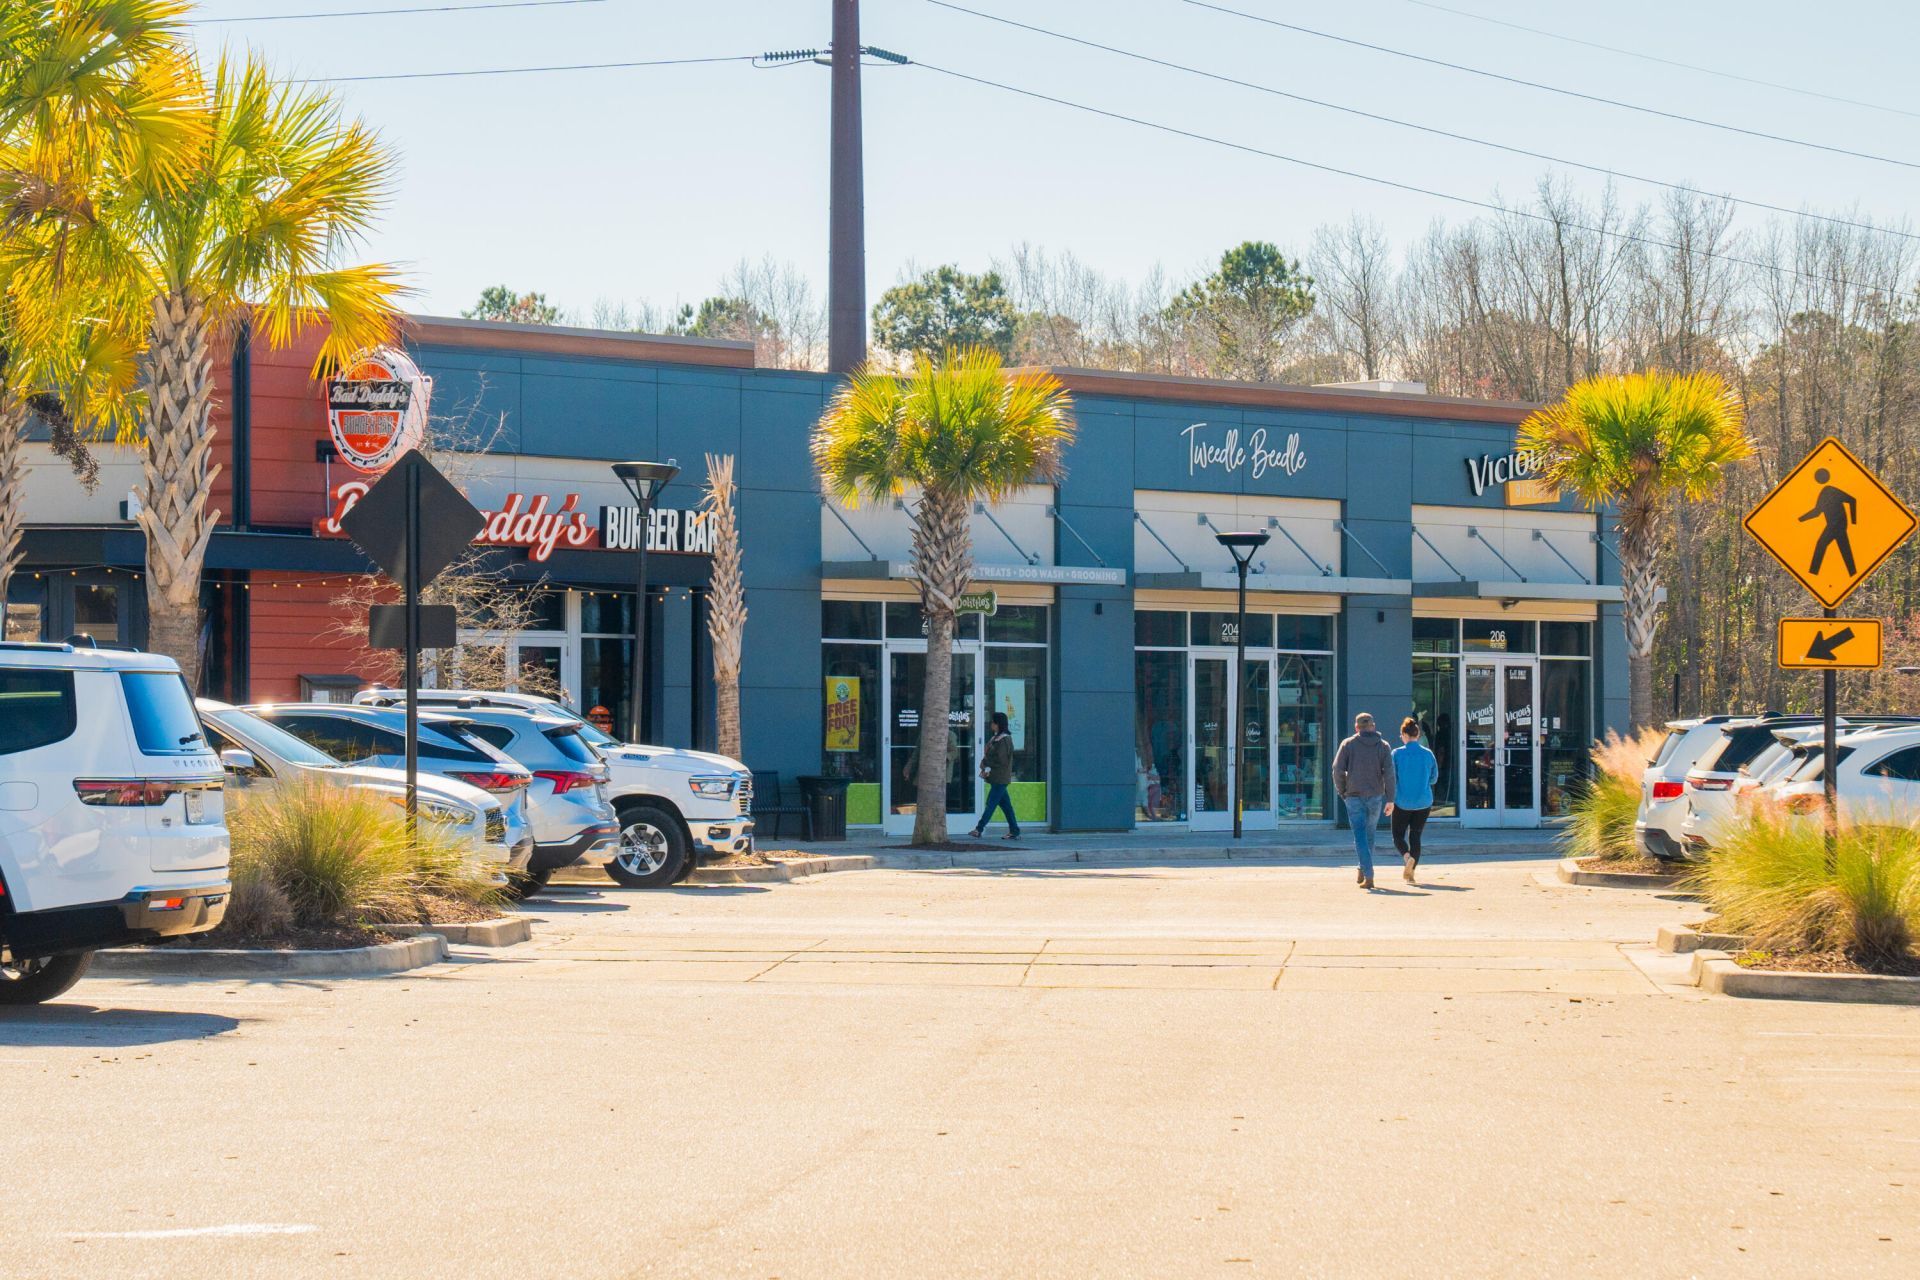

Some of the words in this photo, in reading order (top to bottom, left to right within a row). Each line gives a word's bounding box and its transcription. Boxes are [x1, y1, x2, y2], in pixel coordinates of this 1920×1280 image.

[330, 386, 358, 403] Bad
[358, 386, 408, 408] Daddy's
[343, 415, 375, 434] BURGER
[1180, 422, 1247, 476] Tweedle
[1249, 428, 1306, 479] Beedle
[606, 505, 679, 551] BURGER
[684, 510, 720, 553] BAR
[979, 567, 1011, 577] TREATS
[1018, 569, 1038, 579] DOG
[1040, 570, 1064, 580] WASH
[1071, 570, 1119, 581] GROOMING
[1221, 623, 1239, 636] 204
[1490, 630, 1506, 643] 206
[828, 699, 857, 718] FREE
[1467, 703, 1494, 723] VICIOUS
[1505, 704, 1532, 724] VICIOUS
[828, 713, 857, 732] FOOD
